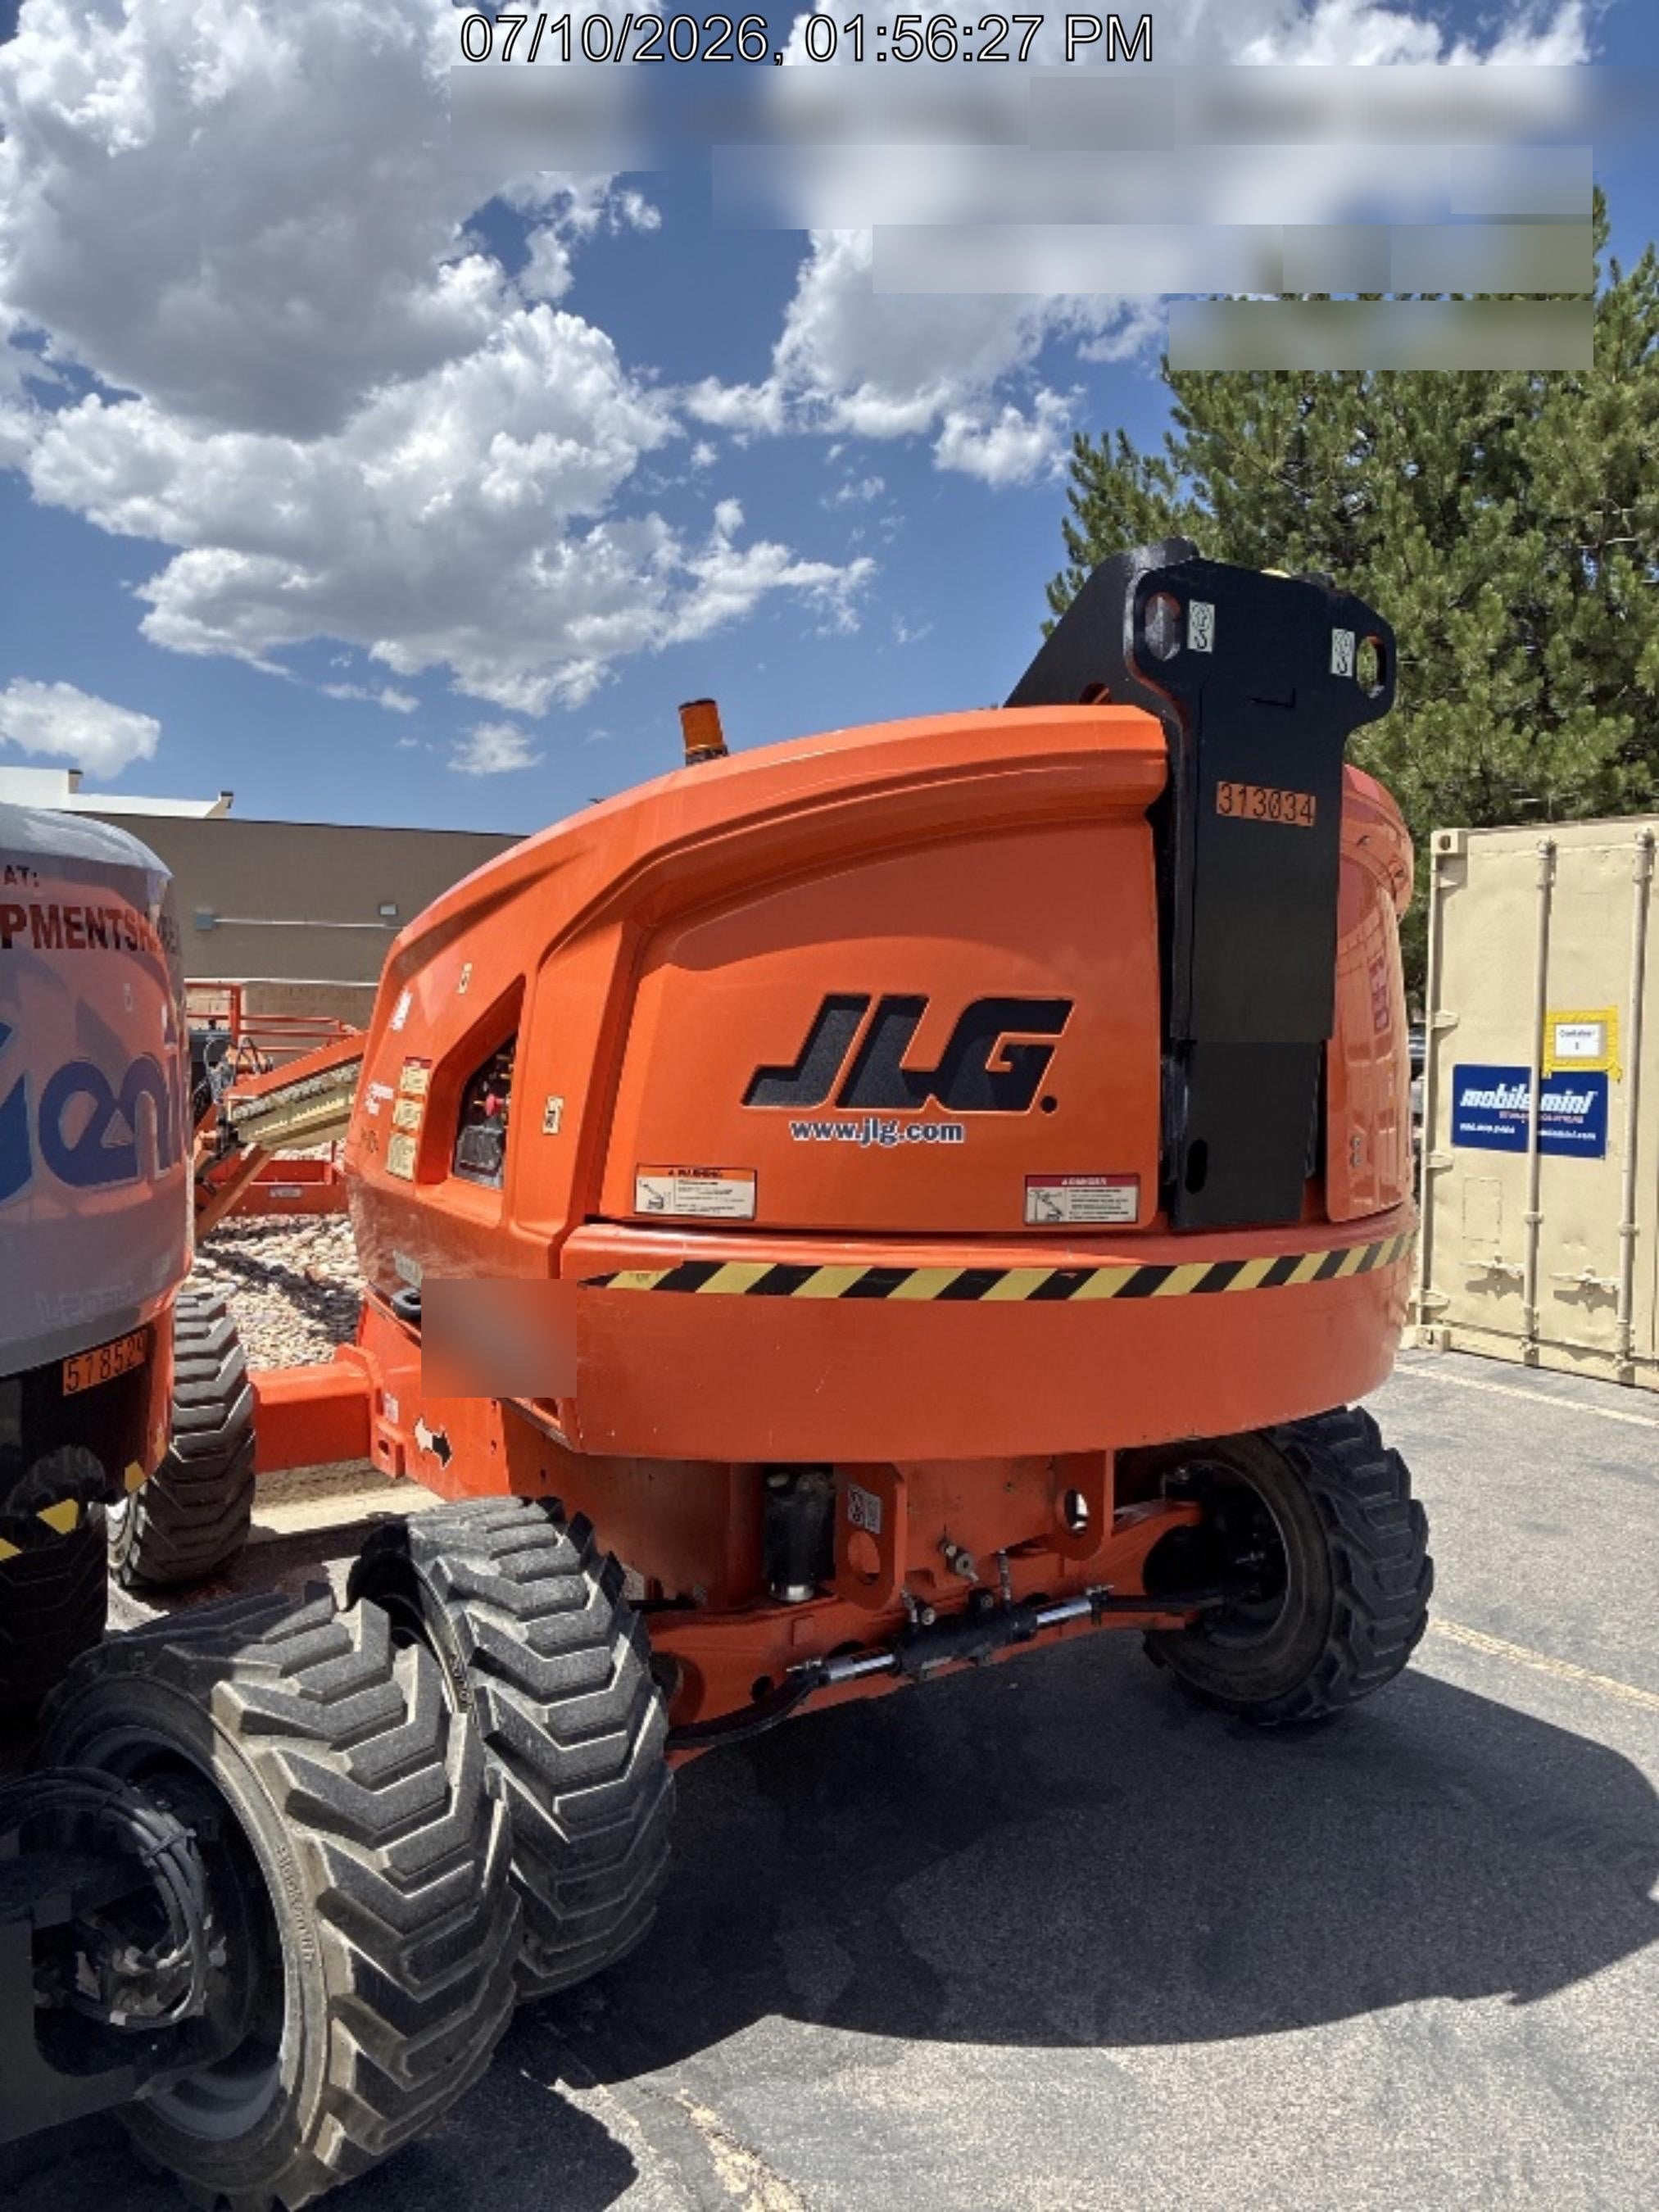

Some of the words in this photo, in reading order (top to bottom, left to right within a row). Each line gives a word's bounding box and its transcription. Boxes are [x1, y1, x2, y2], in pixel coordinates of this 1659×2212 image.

[1218, 782, 1312, 823] 313034
[3, 863, 40, 888] AT:
[789, 1117, 965, 1148] www.jlg.com
